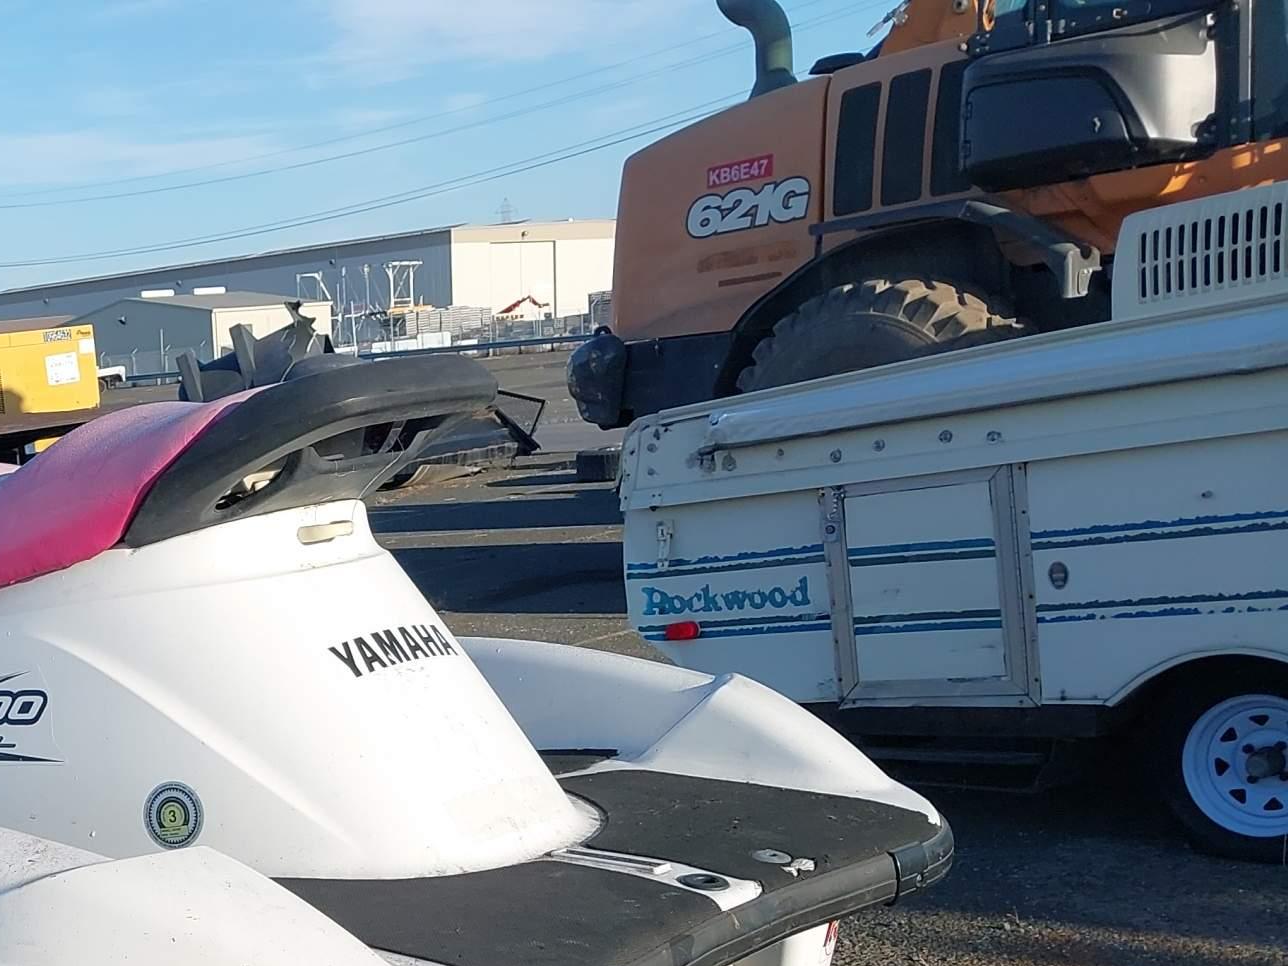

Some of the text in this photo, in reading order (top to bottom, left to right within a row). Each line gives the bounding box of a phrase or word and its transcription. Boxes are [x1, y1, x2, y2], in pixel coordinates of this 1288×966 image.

[708, 158, 769, 186] KB6E47
[686, 175, 811, 239] 621G
[641, 575, 811, 616] Rockwood
[327, 624, 460, 678] YAMAHA
[168, 809, 177, 823] 3
